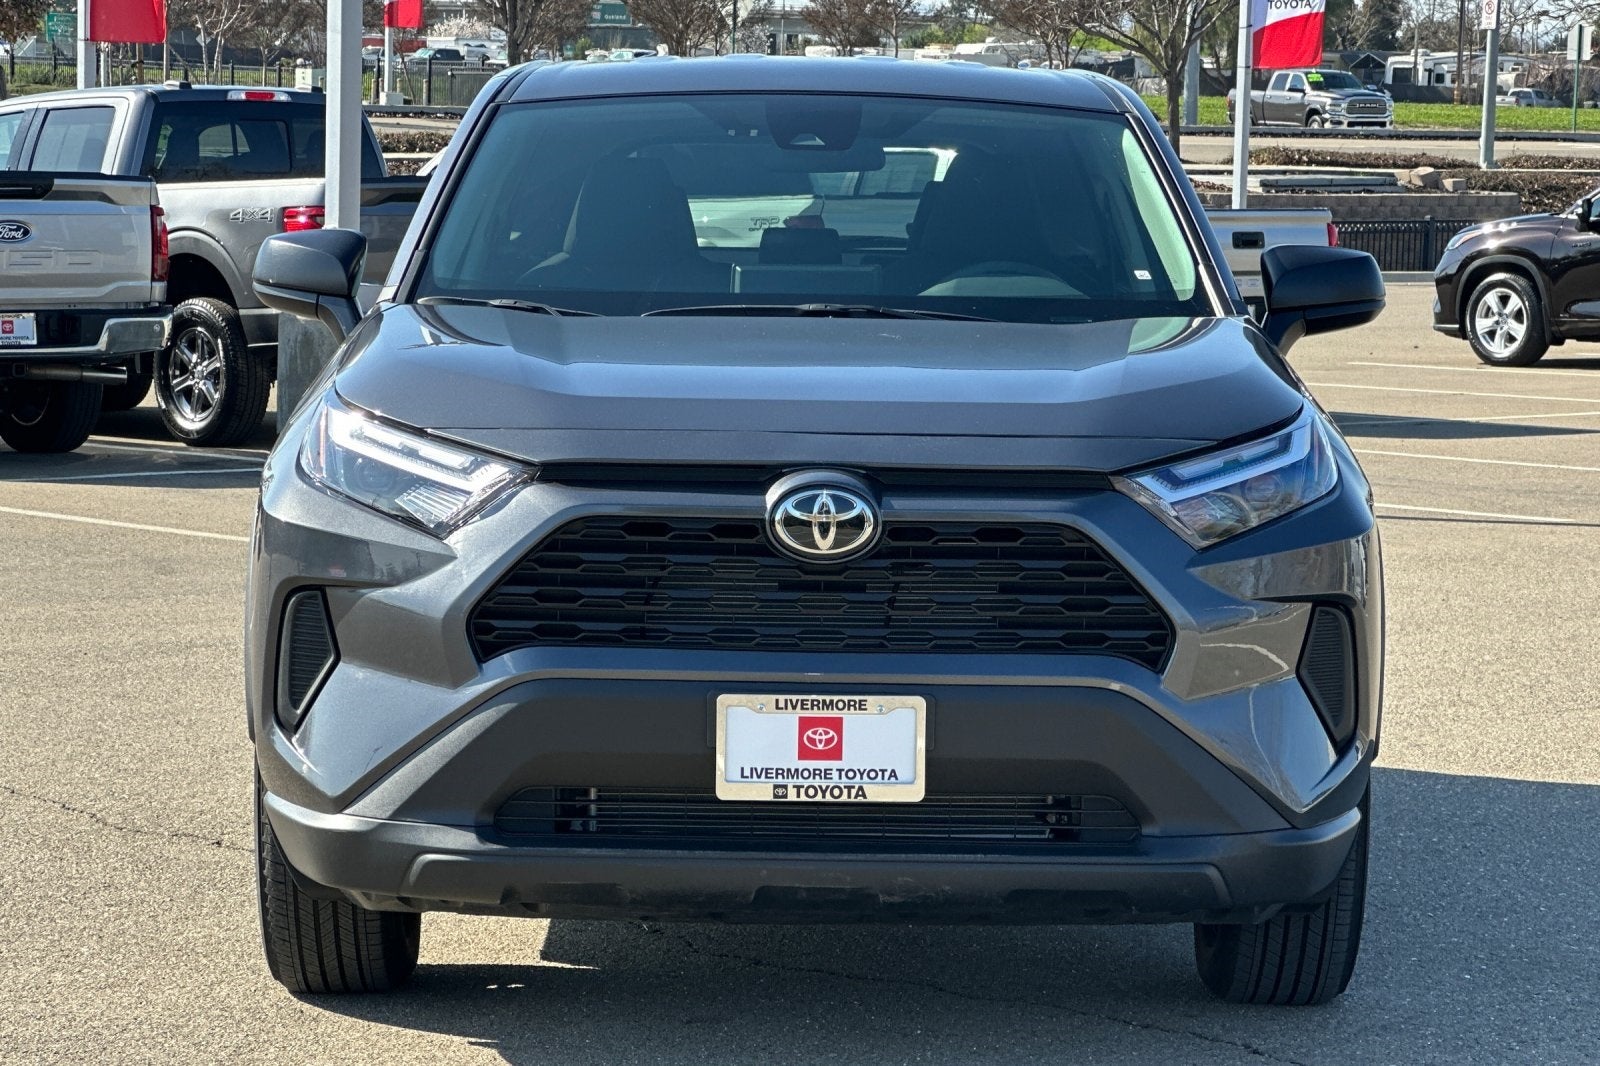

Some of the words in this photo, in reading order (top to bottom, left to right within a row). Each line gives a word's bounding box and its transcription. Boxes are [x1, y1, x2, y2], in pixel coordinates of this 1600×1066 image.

[1268, 0, 1312, 9] TOYOTA
[0, 224, 24, 239] Ford
[774, 698, 868, 712] LIVERMORE
[740, 766, 833, 780] LIVERMORE
[836, 768, 899, 781] TOYOTA
[792, 784, 868, 800] TOYOTA
